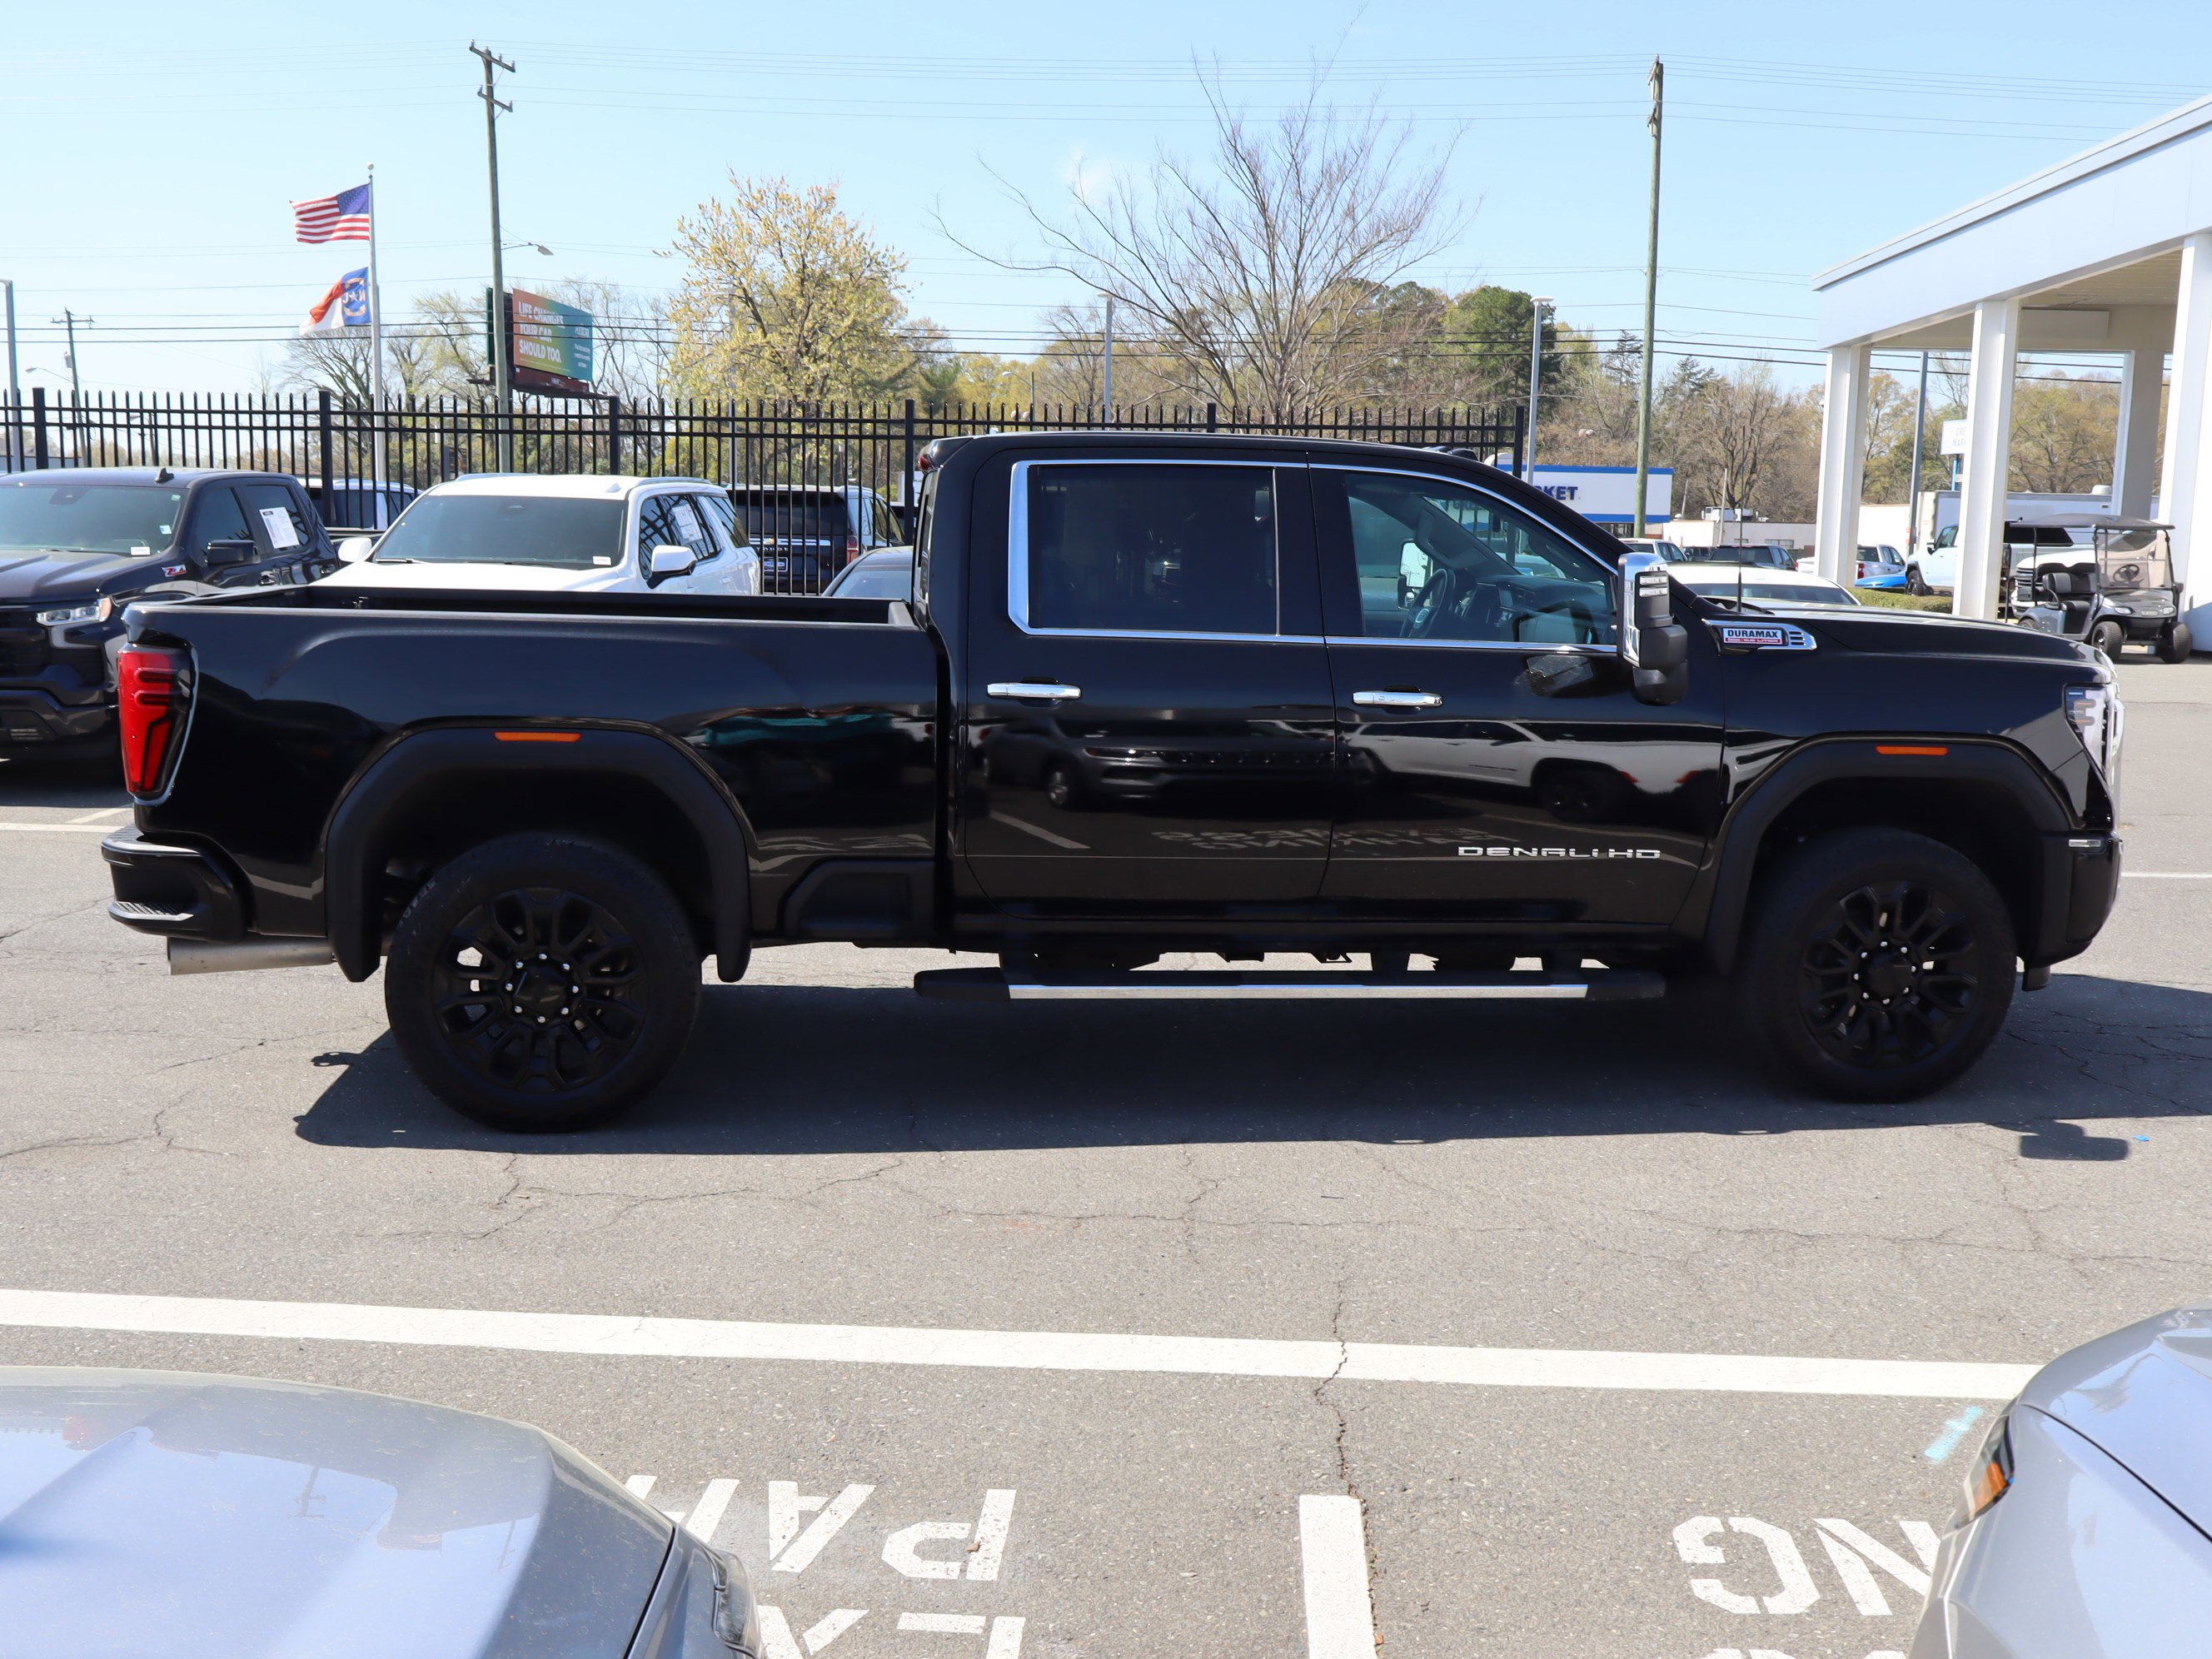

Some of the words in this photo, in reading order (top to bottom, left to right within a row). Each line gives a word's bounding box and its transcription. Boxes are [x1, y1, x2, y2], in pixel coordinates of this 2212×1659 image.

[518, 301, 533, 319] LIFE
[519, 321, 538, 339] YOUR
[539, 326, 552, 343] CAR
[519, 338, 546, 359] SHOULD
[1727, 629, 1778, 638] DURAMAX
[1457, 846, 1599, 858] DENALI
[1607, 848, 1661, 859] HD
